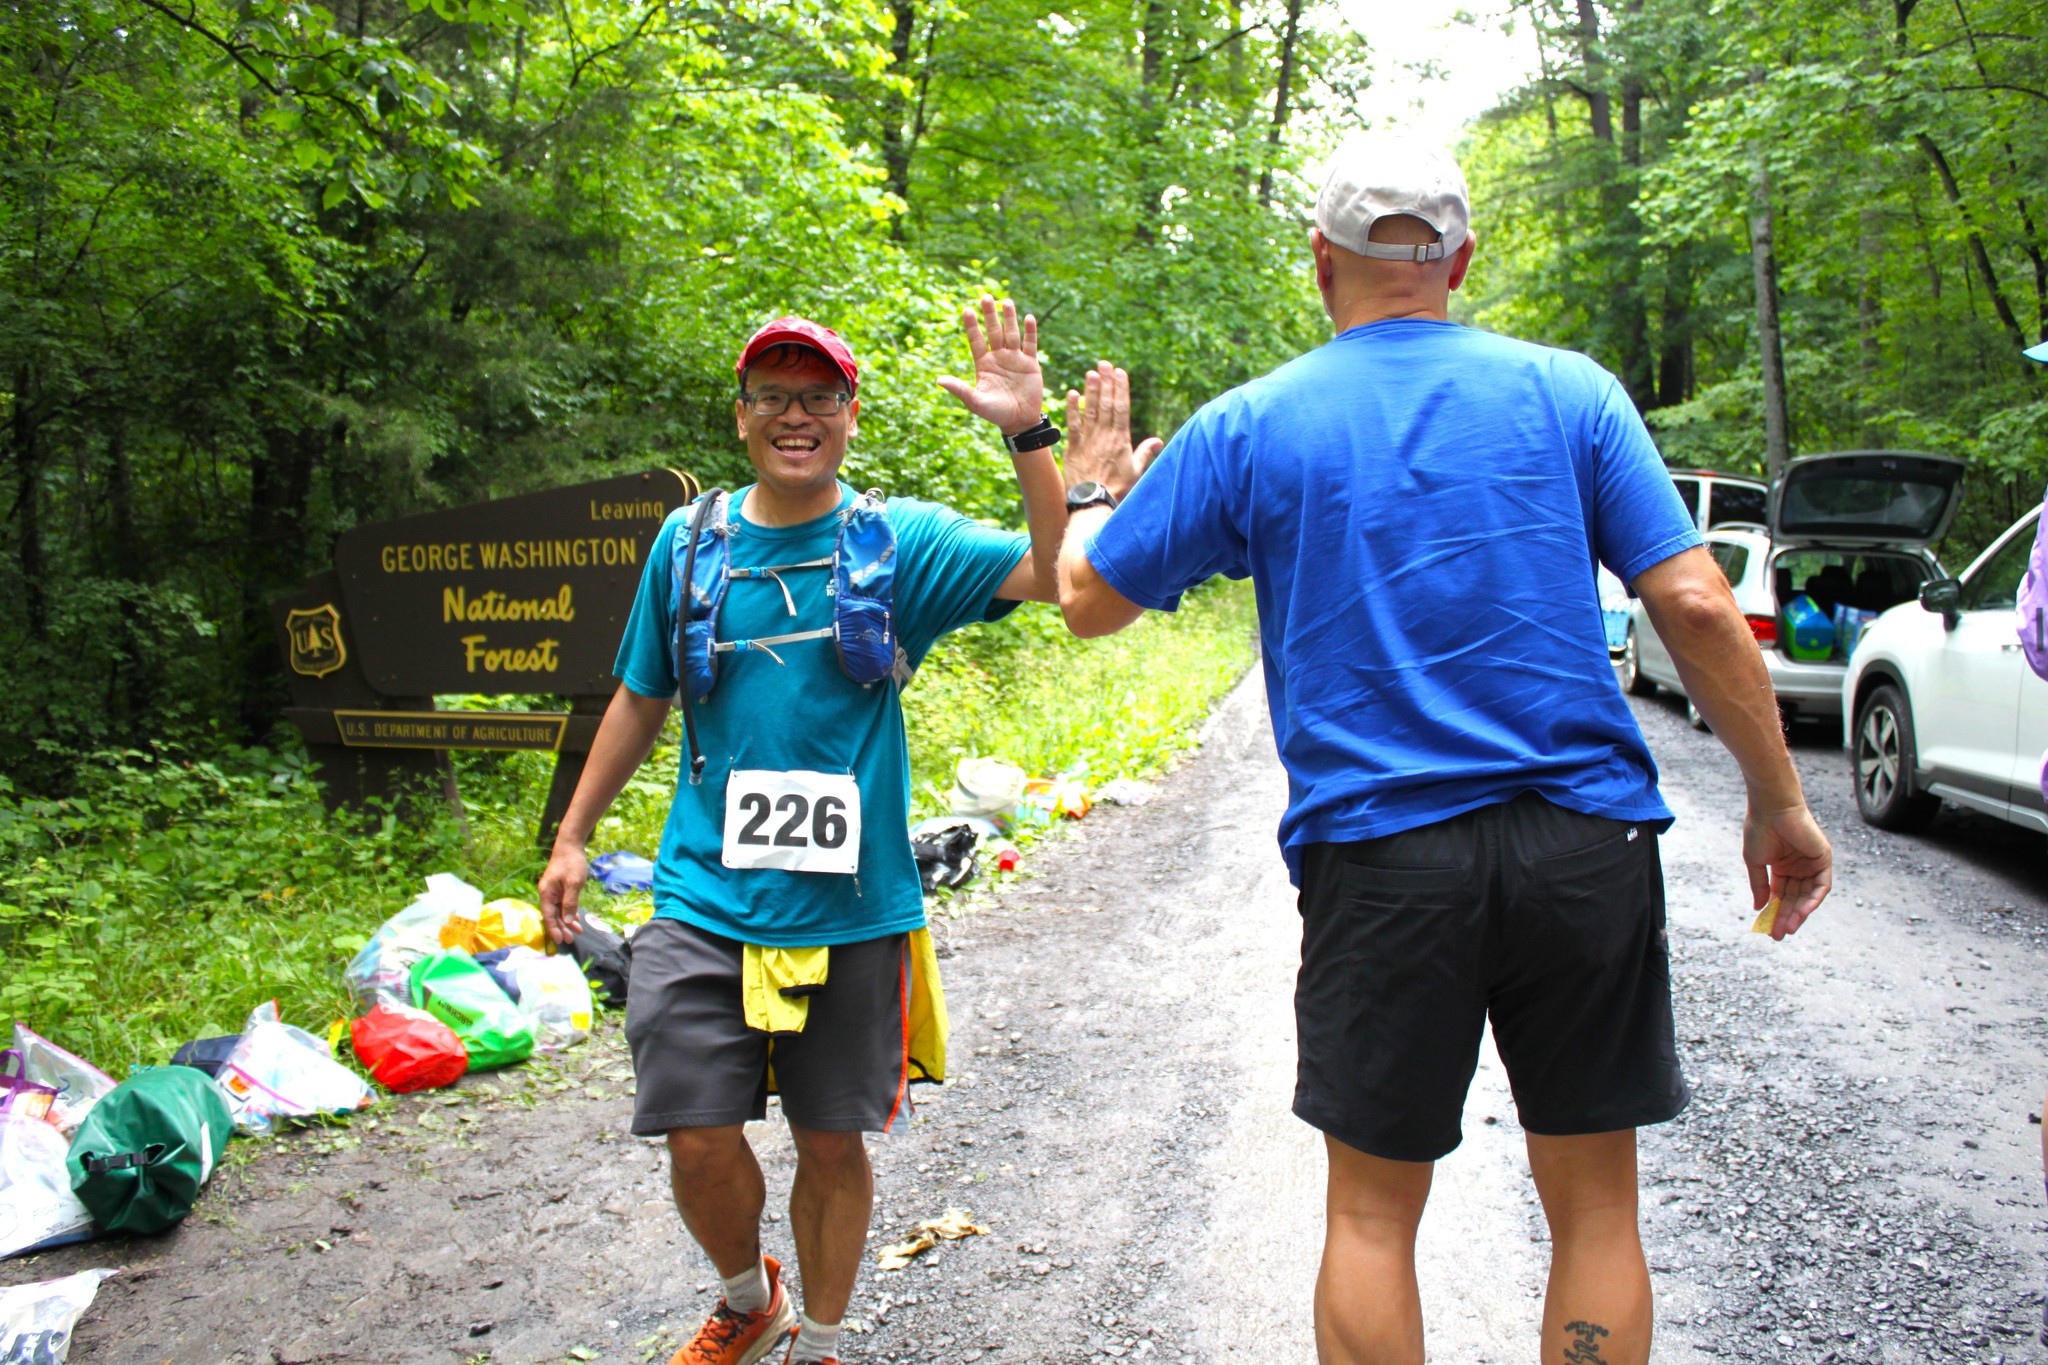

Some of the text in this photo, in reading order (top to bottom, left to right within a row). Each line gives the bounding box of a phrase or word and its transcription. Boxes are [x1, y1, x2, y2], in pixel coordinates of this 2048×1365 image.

[590, 498, 665, 525] Leaving
[381, 537, 638, 573] GEORGE WASHINGTON
[442, 583, 576, 624] National
[460, 634, 560, 674] Forest
[346, 722, 553, 743] U.S. DEPARTMENT OF AGRICULTURE
[737, 792, 848, 850] 226
